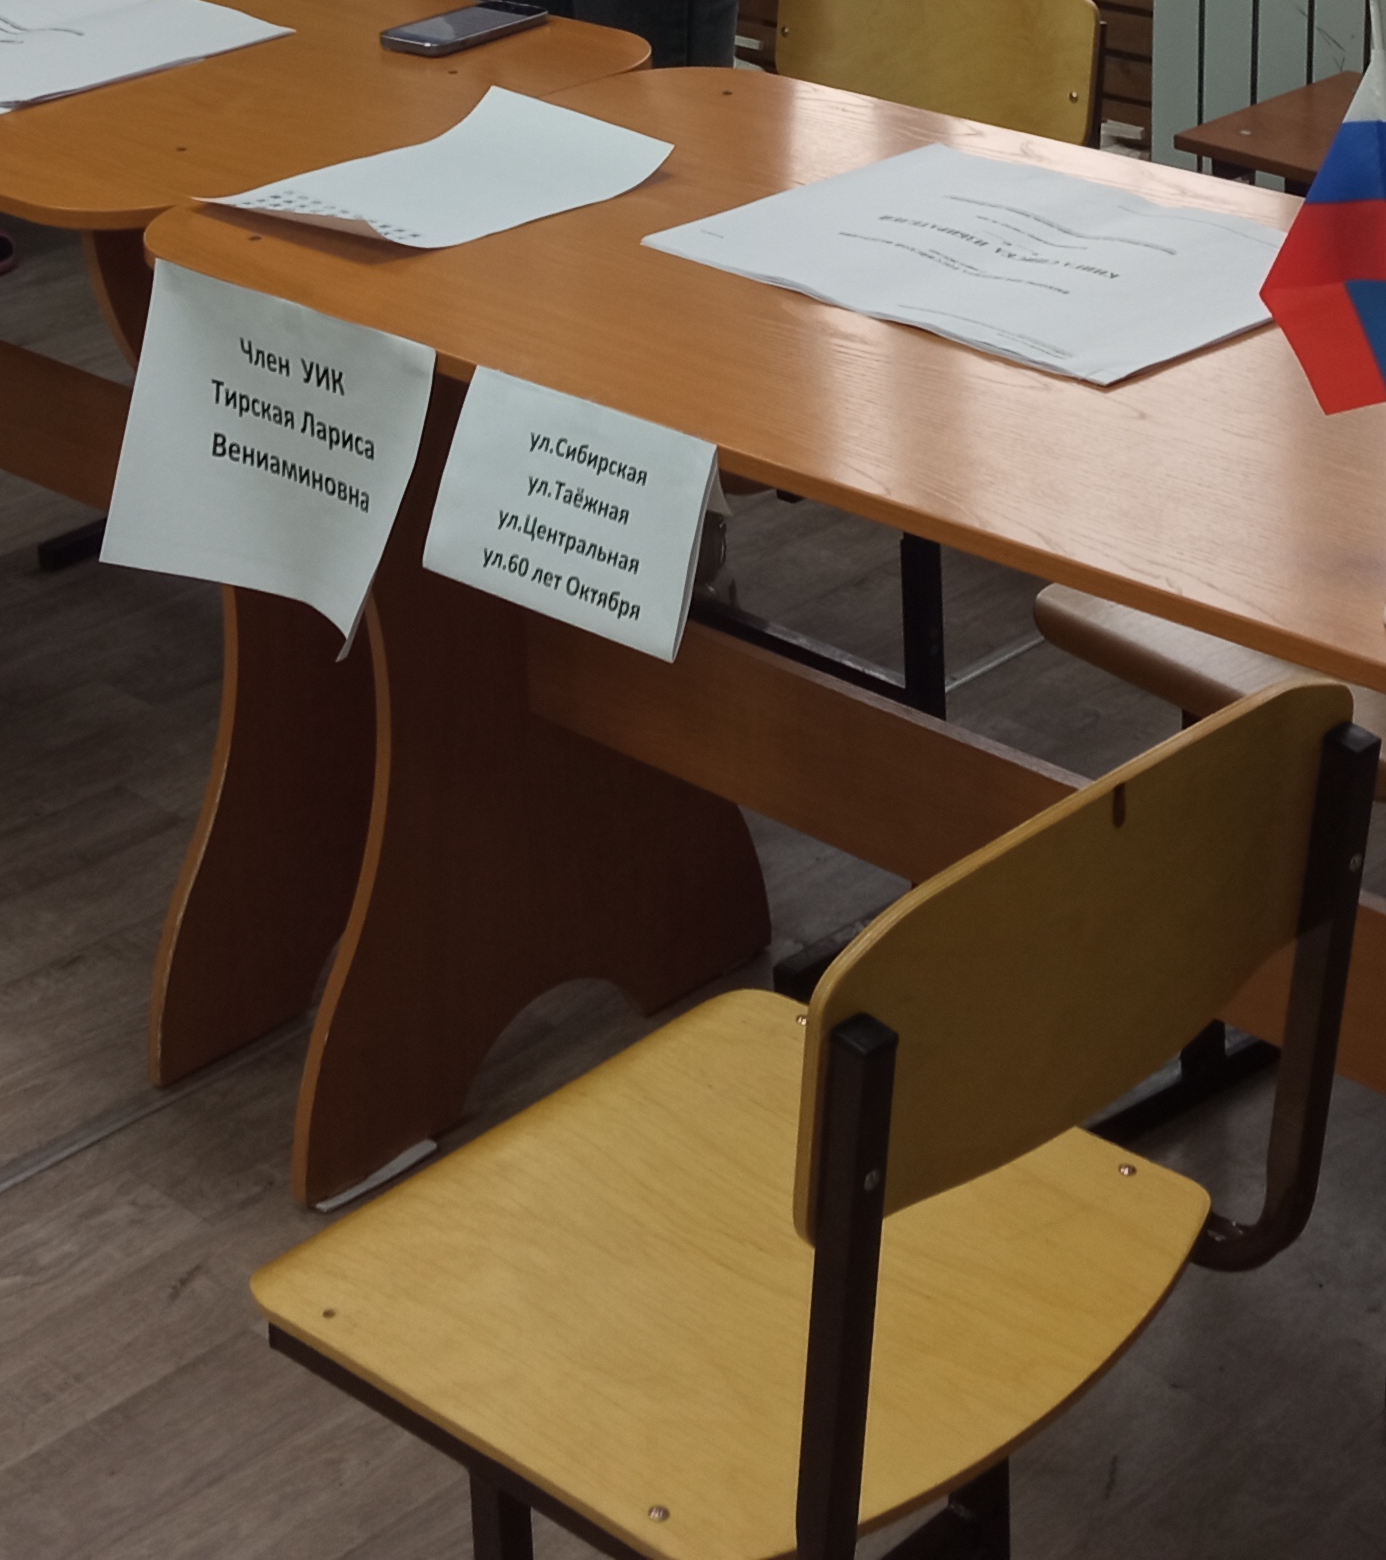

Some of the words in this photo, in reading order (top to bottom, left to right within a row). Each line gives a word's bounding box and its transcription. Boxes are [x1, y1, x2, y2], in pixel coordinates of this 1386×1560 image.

[239, 336, 291, 377] Член
[300, 357, 345, 397] УИК
[211, 378, 295, 430] Тирская
[300, 410, 375, 461] Лариса
[211, 431, 370, 514] Вениаминовна
[529, 432, 648, 487] ул.Сибирская
[527, 475, 631, 526] ул.Таёжная
[497, 509, 641, 576] ул.Центральная
[482, 546, 530, 578] ул.60
[530, 566, 563, 591] лет
[565, 575, 642, 622] Октября
